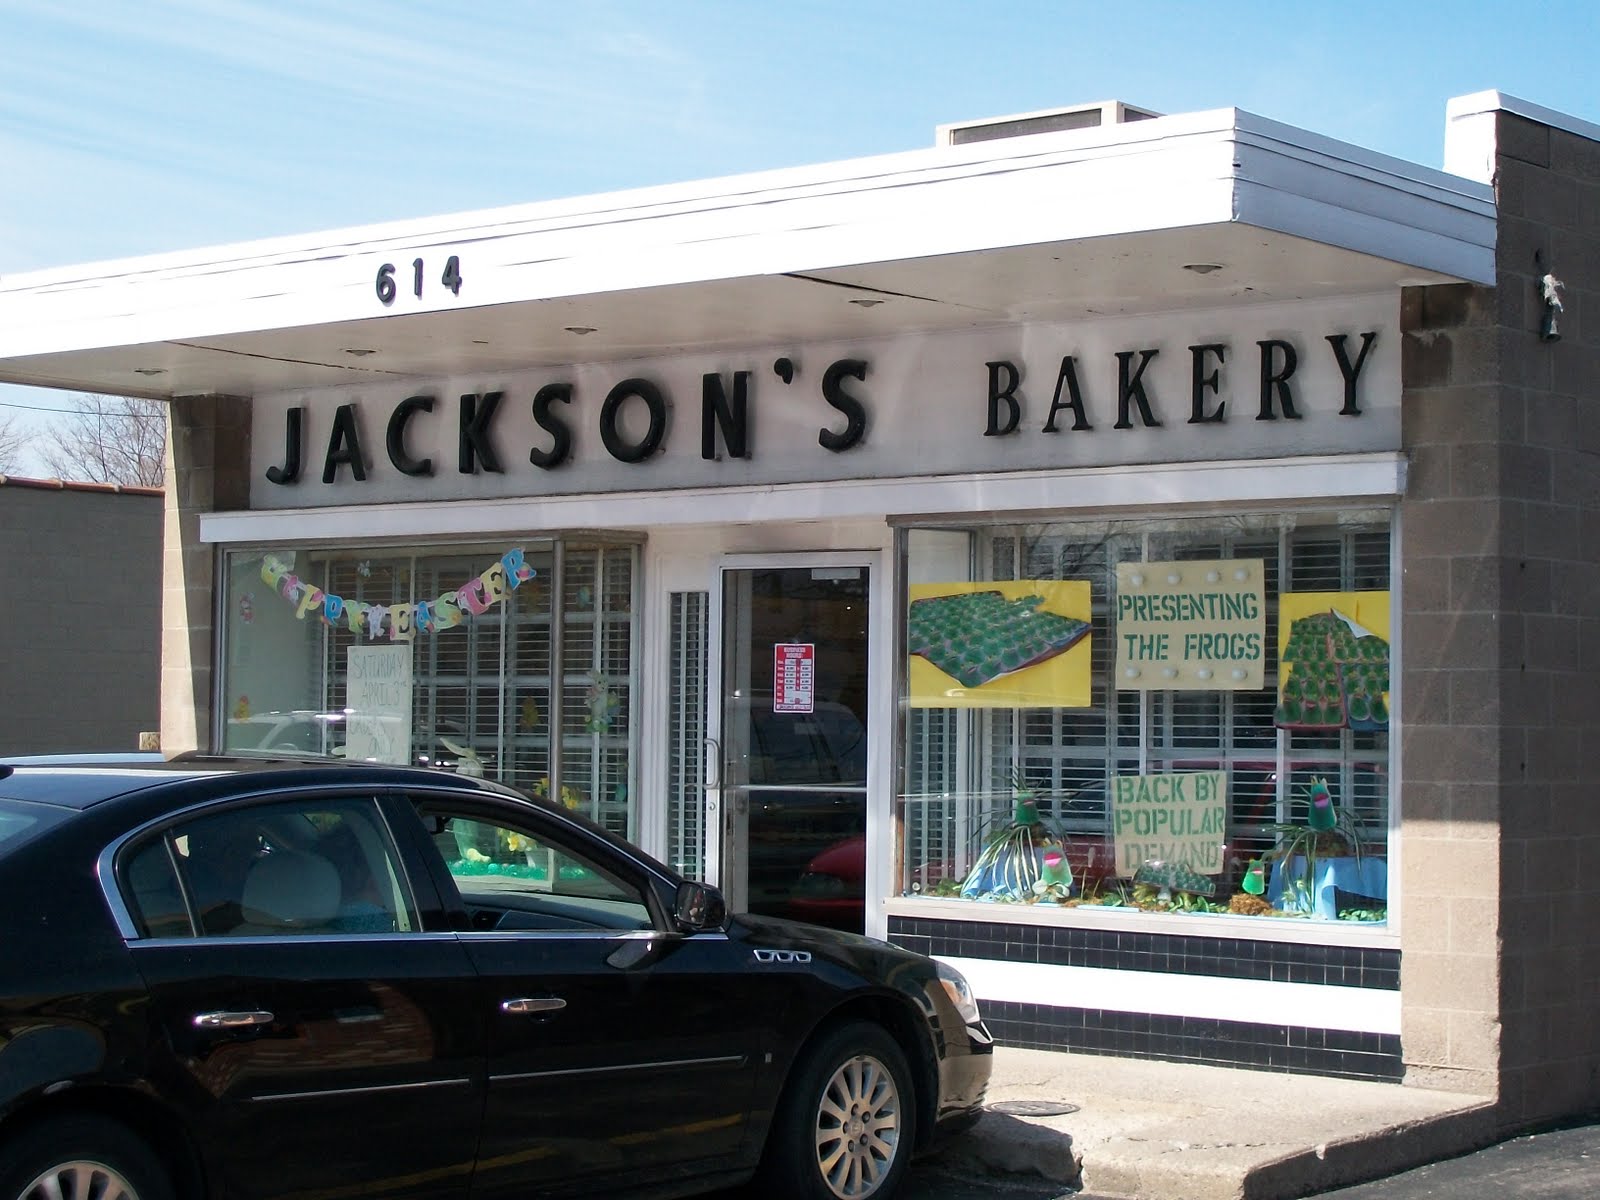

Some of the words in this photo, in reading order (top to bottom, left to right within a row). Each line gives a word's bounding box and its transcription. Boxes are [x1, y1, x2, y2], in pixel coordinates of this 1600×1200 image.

[376, 255, 463, 303] 614
[265, 357, 869, 486] JACKSON'S
[983, 331, 1377, 437] BAKERY
[1117, 592, 1259, 622] PRESENTING
[1123, 633, 1170, 661] THE
[1183, 632, 1261, 661] FROGS
[1116, 775, 1186, 804] BACK
[1195, 773, 1220, 802] BY
[1114, 806, 1226, 836] POPULAR
[1124, 841, 1219, 870] DEMAND
